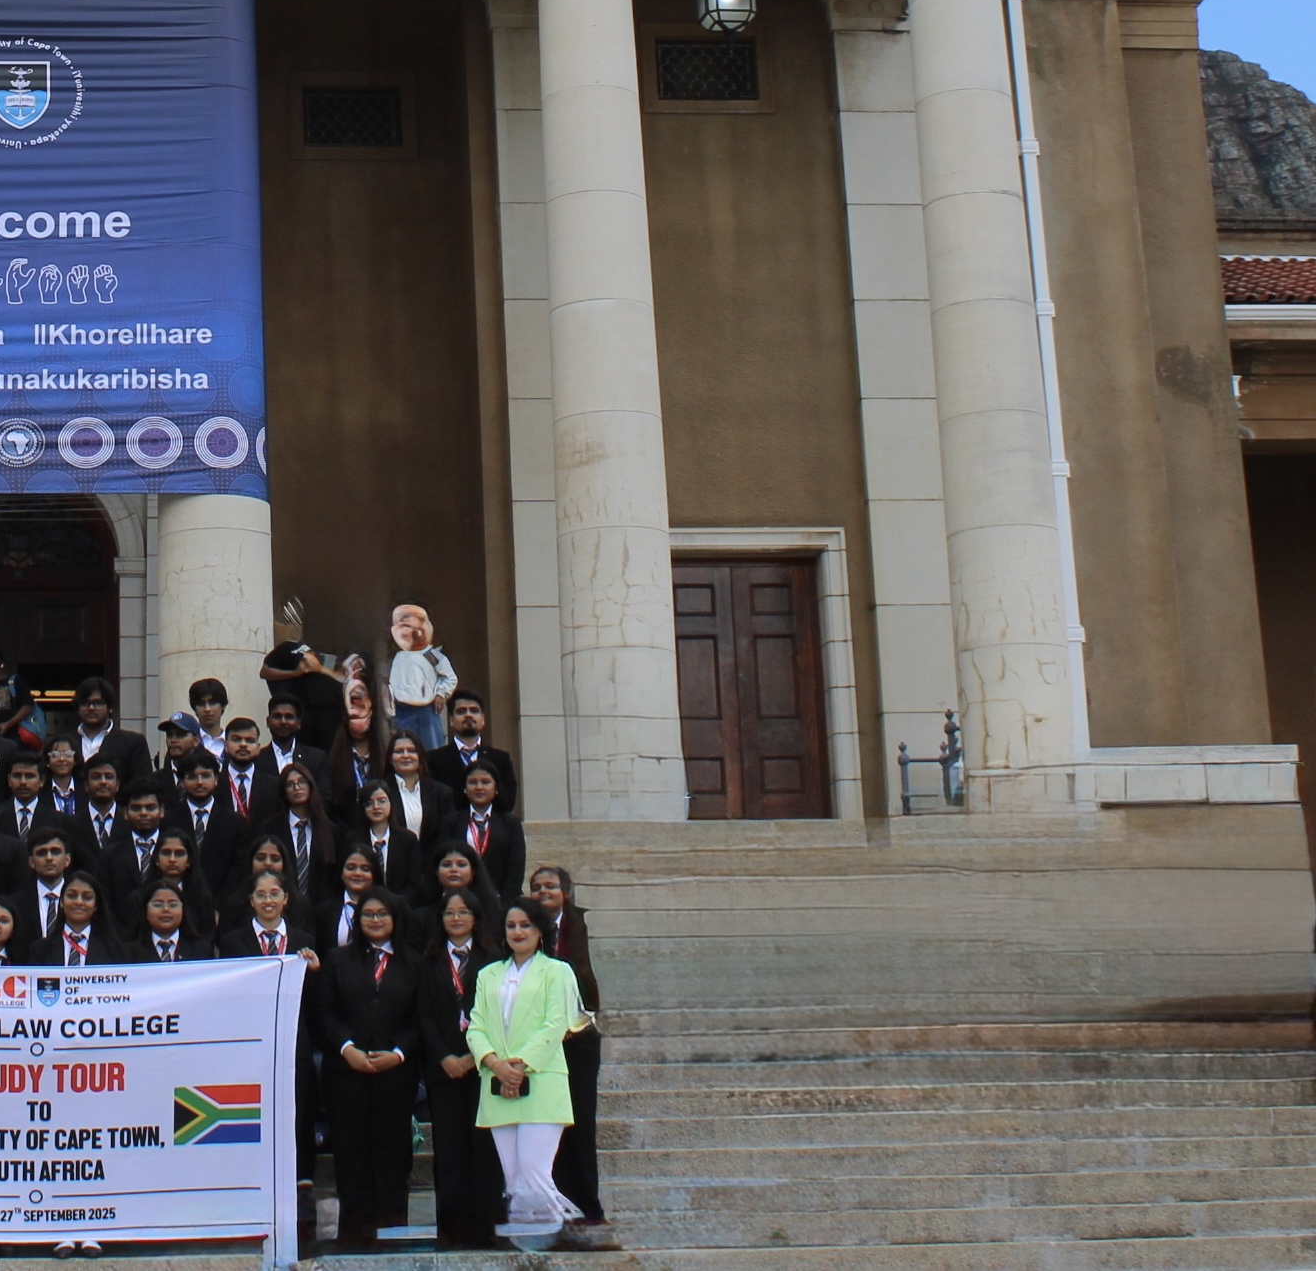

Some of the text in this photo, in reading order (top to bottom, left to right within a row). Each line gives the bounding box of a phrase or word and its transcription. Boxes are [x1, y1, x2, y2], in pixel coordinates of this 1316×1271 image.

[14, 36, 25, 46] of
[27, 38, 51, 51] Cape
[52, 46, 72, 66] Town
[64, 974, 128, 986] UNIVERSITY
[64, 986, 79, 995] OF
[64, 994, 131, 1006] CAPE TOWN
[60, 1014, 180, 1038] COLLEGE
[51, 1062, 125, 1093] TOUR
[26, 1100, 52, 1122] TO
[25, 1129, 51, 1150] OF
[54, 1128, 103, 1150] CAPE
[107, 1126, 165, 1149] TOWN,
[38, 1159, 105, 1181] AFRICA
[23, 1208, 86, 1222] SEPTEMBER
[88, 1207, 116, 1220] 2025
